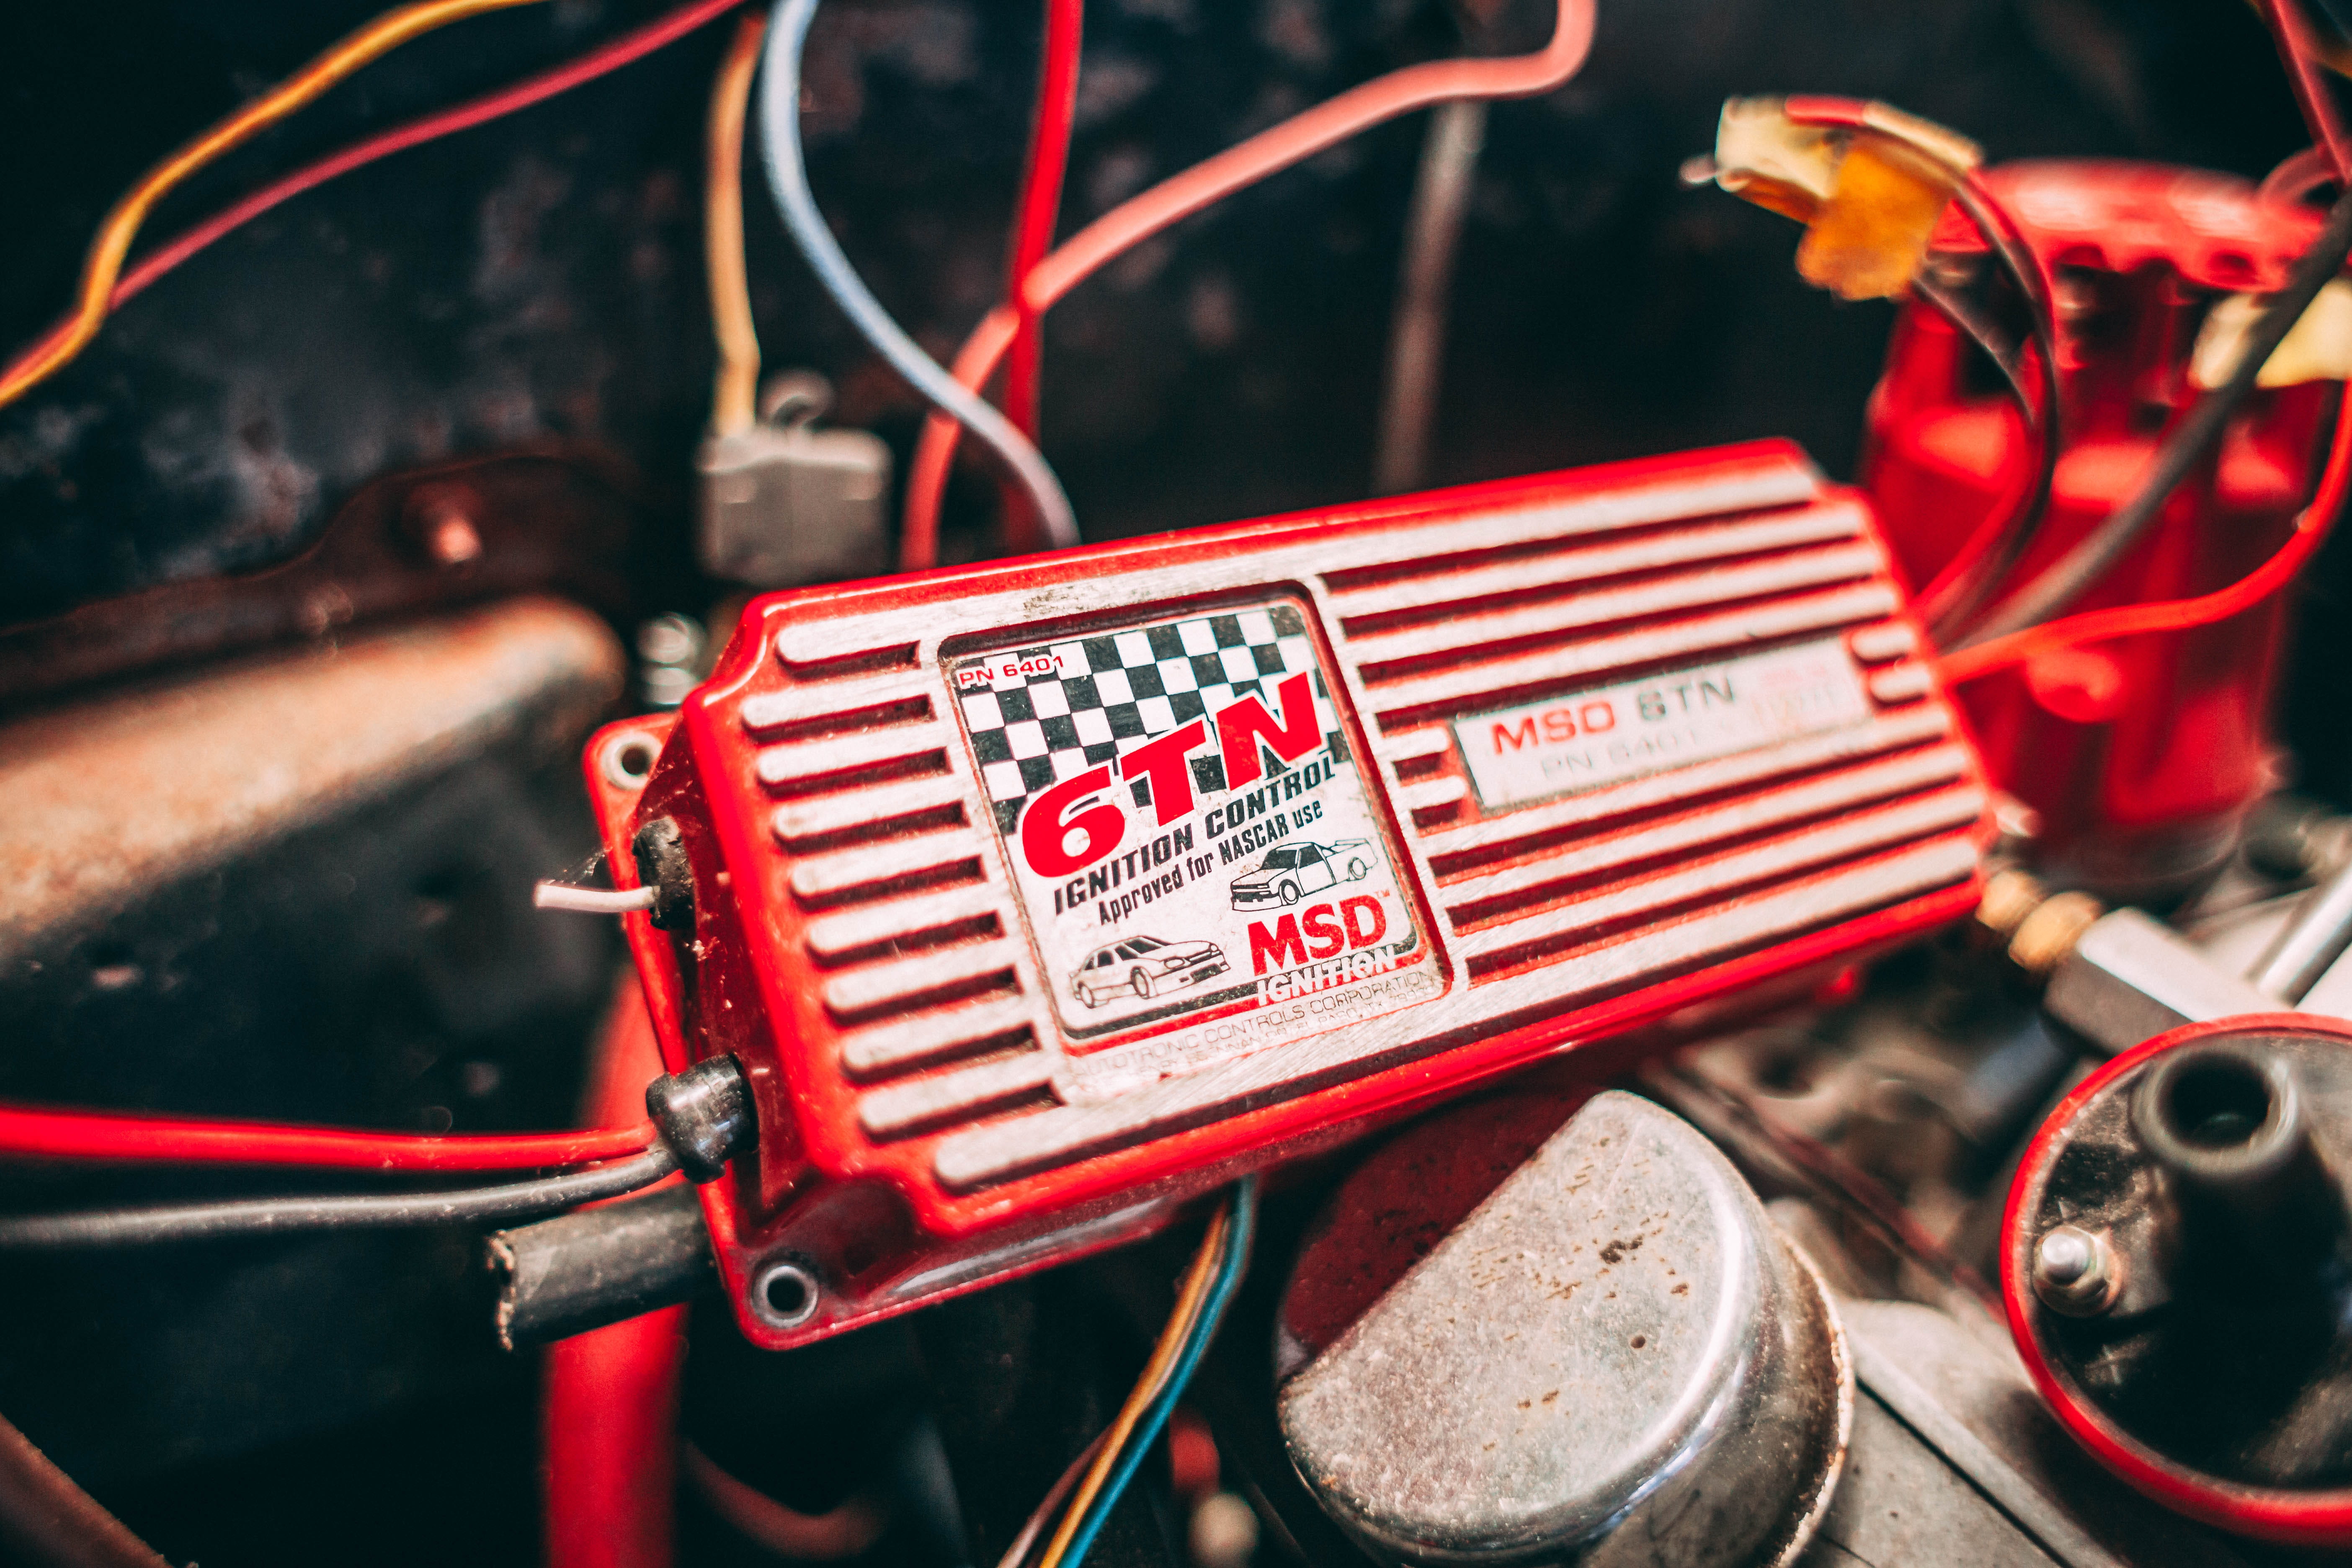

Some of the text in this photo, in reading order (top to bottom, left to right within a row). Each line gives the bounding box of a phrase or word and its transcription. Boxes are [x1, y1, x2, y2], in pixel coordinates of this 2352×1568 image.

[959, 656, 1063, 685] PN 6401
[1491, 701, 1615, 755] MSD
[1022, 672, 1322, 878] 6TN
[1054, 756, 1335, 916] IGNITION CONTROL
[1099, 800, 1323, 926] Approved for NASCAR use
[1248, 895, 1386, 976] MSD
[1204, 1005, 1305, 1043] CONTROLS
[1310, 971, 1433, 1014] CORPORATION
[1256, 945, 1396, 1006] IGNITION
